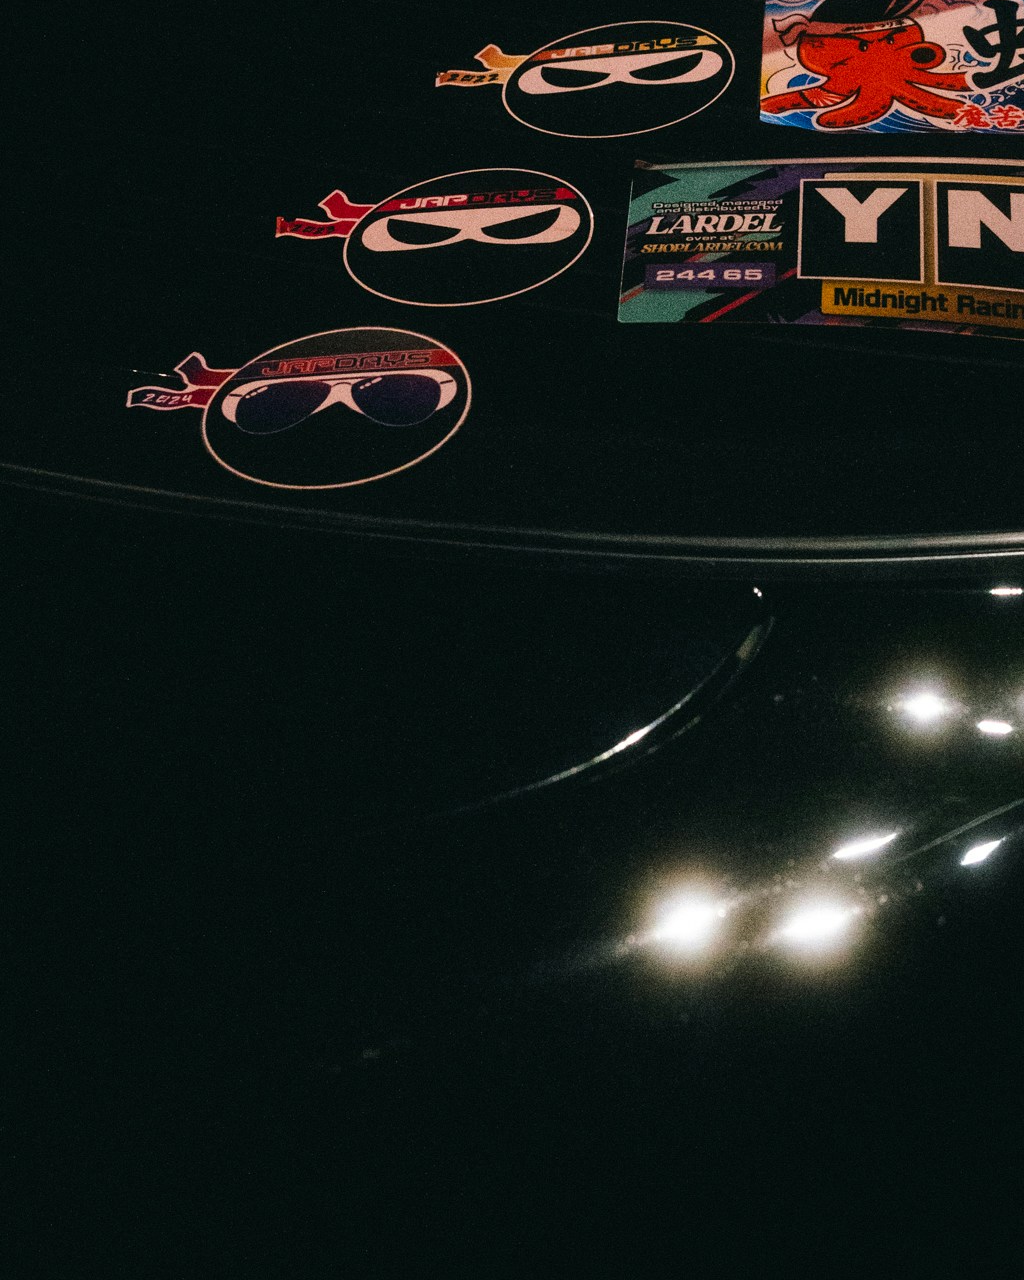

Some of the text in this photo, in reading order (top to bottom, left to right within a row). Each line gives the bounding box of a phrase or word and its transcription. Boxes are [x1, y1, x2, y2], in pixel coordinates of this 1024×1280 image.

[684, 205, 758, 213] distributed
[760, 204, 778, 212] by
[721, 199, 783, 208] managed
[645, 212, 784, 235] LARDEL
[833, 287, 949, 314] Midnight
[262, 351, 433, 377] JAPDAYS
[141, 392, 193, 406] 2024
